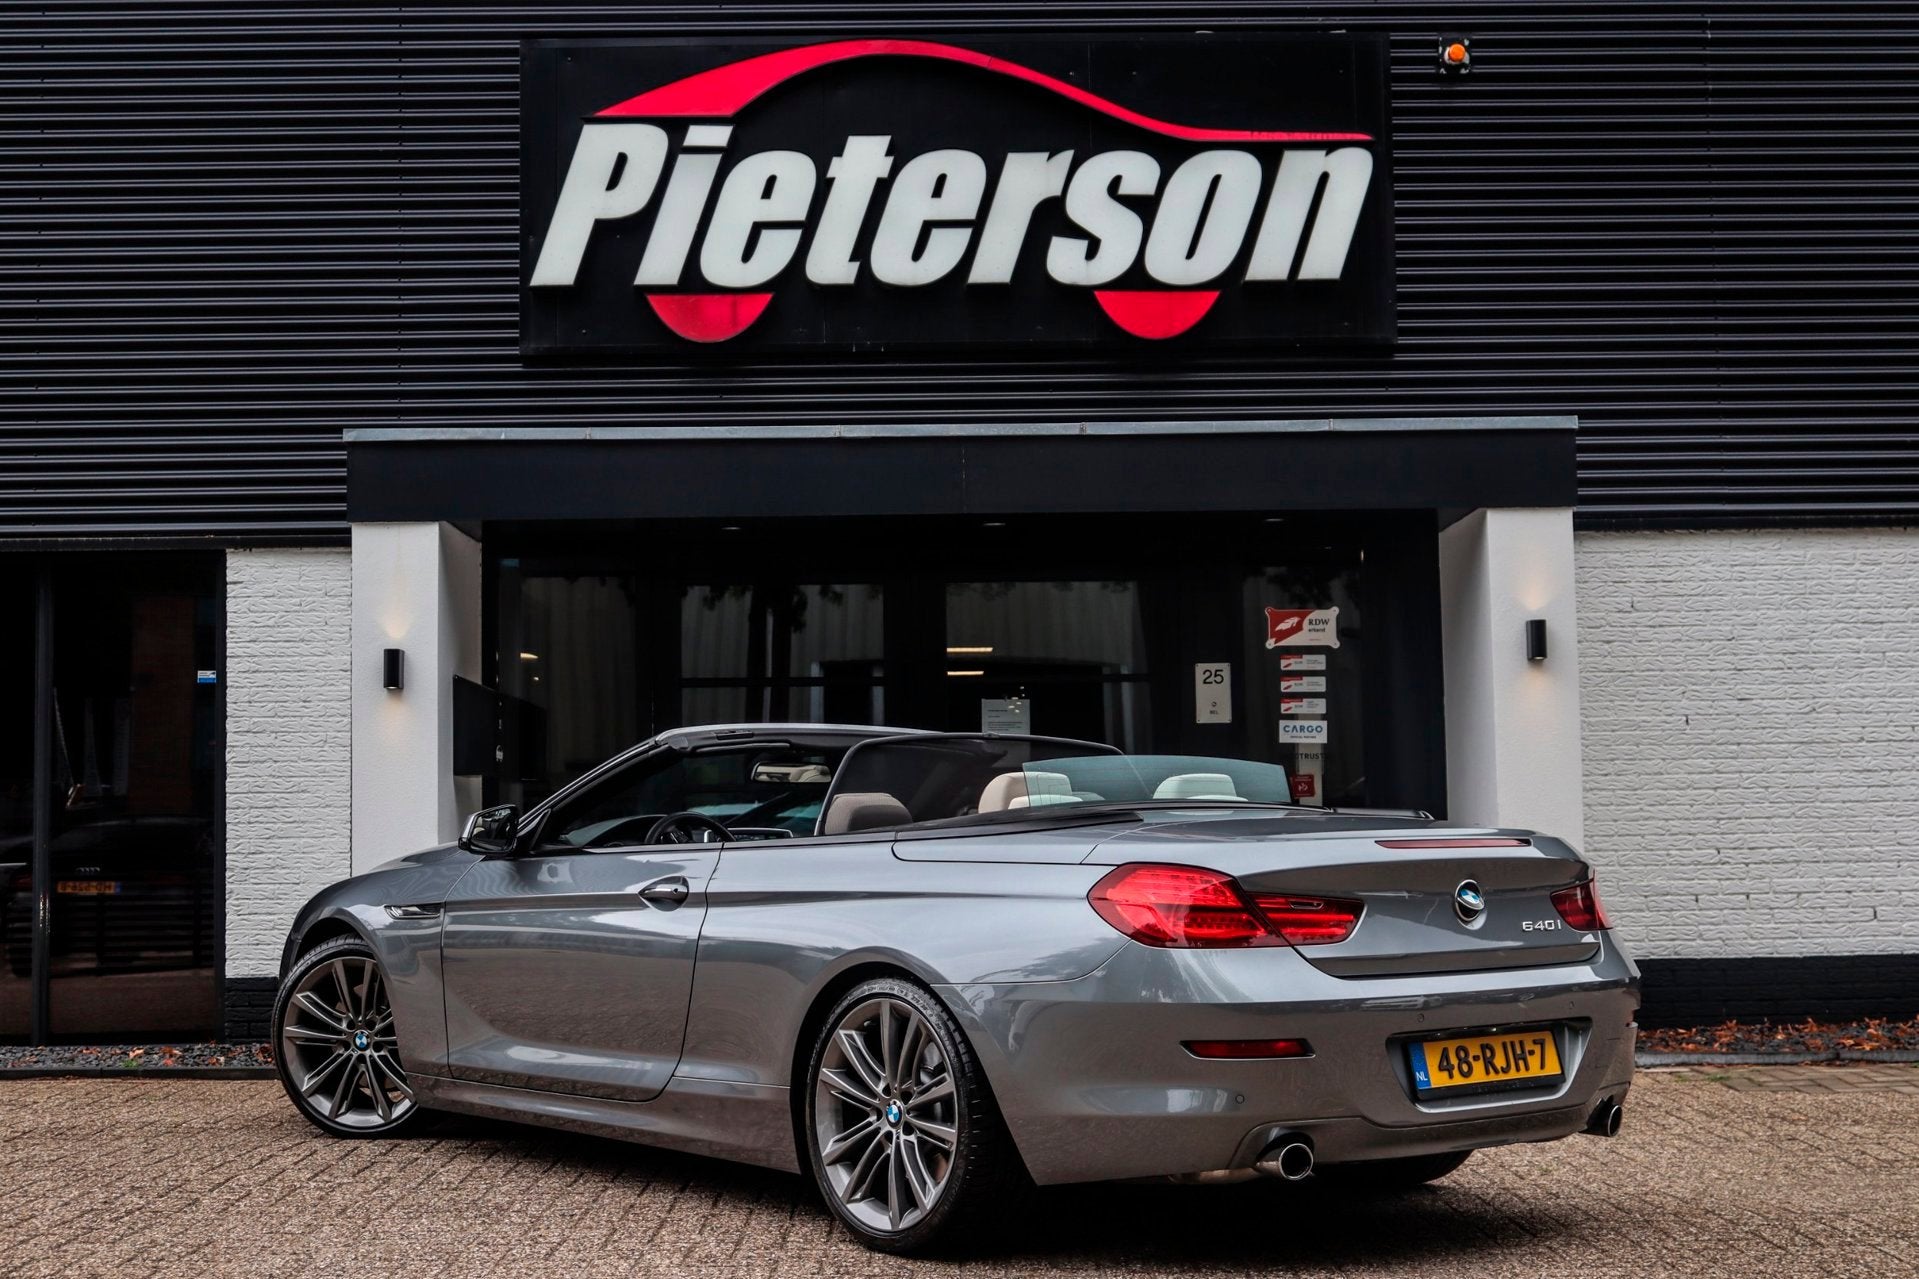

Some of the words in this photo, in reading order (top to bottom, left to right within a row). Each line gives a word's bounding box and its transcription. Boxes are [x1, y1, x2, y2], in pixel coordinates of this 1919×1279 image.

[529, 123, 1374, 288] Pieterson
[1308, 618, 1330, 626] RDW
[1202, 669, 1225, 685] 25
[1283, 724, 1324, 733] CARGO
[1438, 1038, 1546, 1079] 48-RJH-7
[1415, 1070, 1429, 1082] NL
